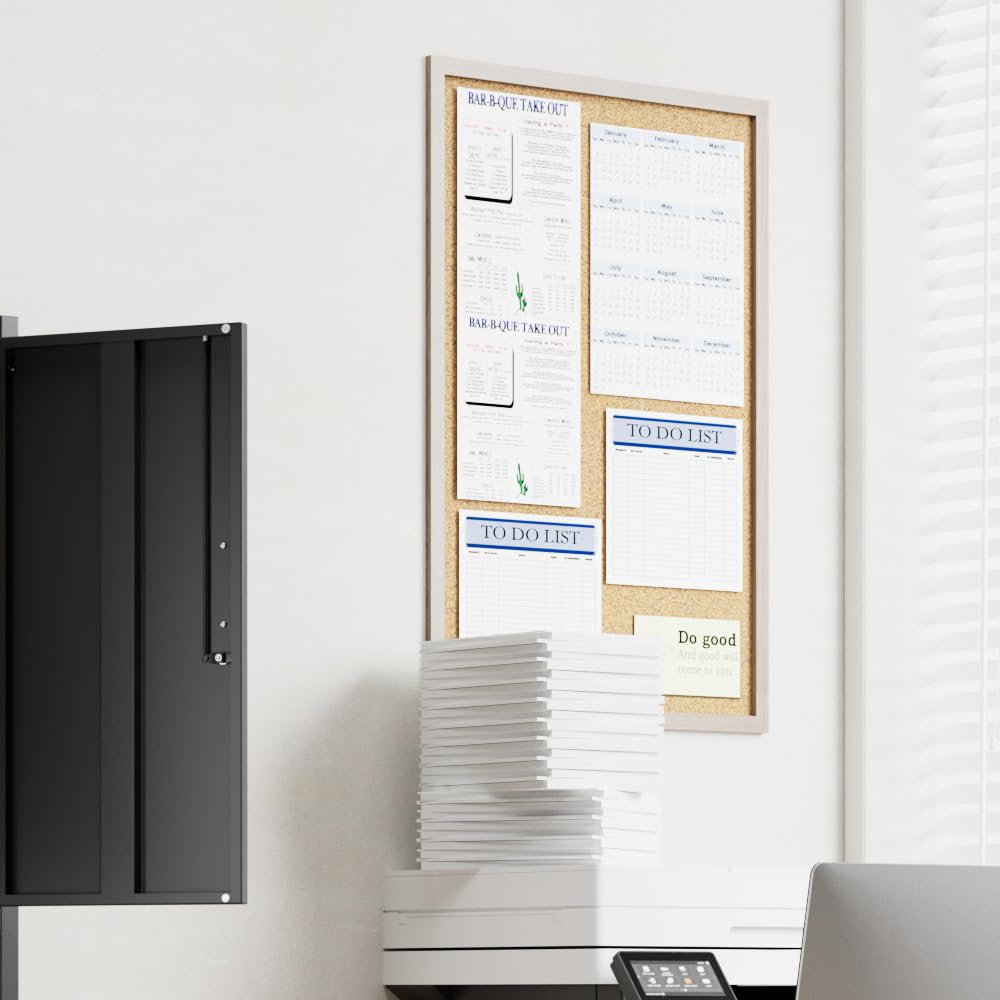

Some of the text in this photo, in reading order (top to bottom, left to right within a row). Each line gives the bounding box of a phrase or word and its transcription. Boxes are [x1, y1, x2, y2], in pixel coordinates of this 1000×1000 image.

[467, 91, 569, 116] BAR-B-QUE TAKE OUT
[469, 316, 570, 337] BAR-B-QUE TAKE OUT
[627, 423, 723, 444] TO DO LIST
[481, 524, 581, 545] TO DO LIST
[678, 630, 737, 649] Do good
[698, 650, 720, 662] good
